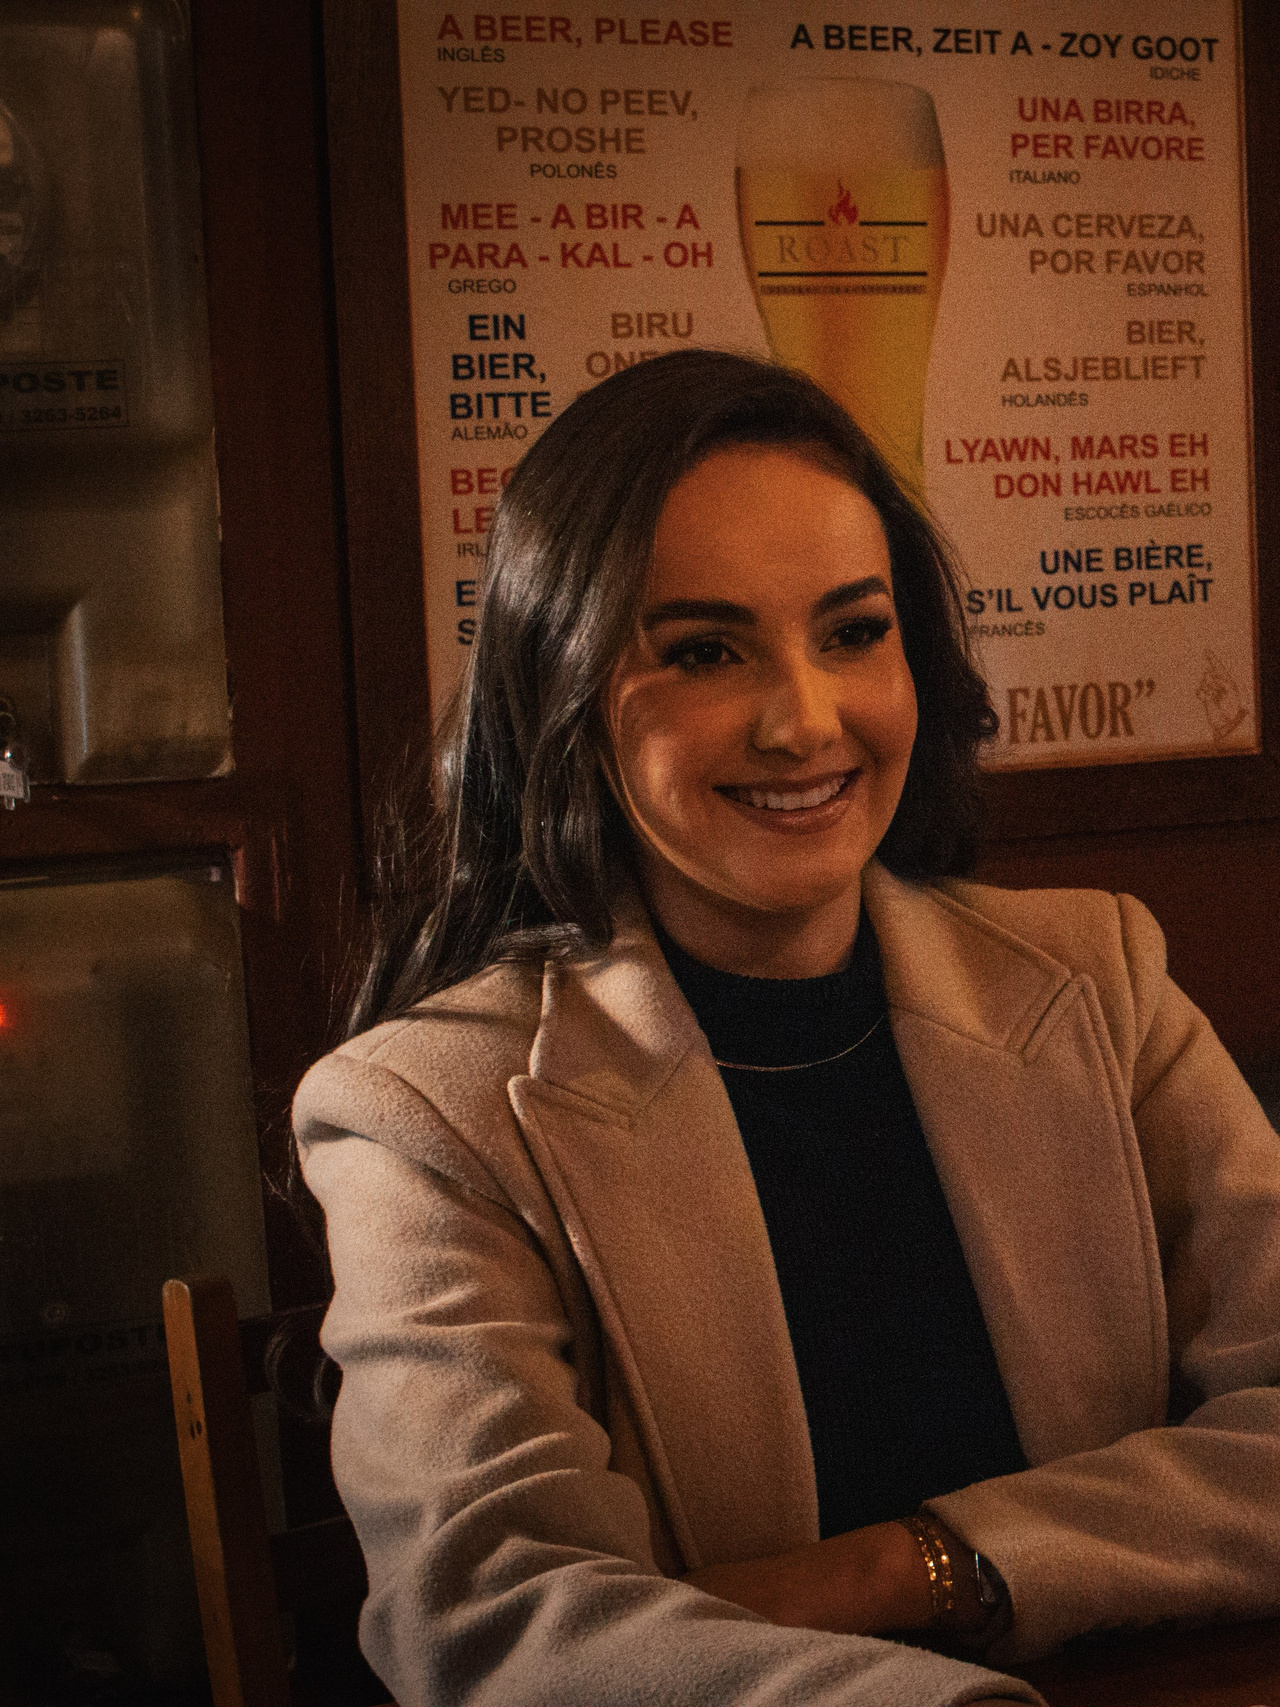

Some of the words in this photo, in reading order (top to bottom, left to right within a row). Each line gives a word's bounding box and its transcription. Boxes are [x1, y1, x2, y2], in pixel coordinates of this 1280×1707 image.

[438, 14, 463, 40] A
[474, 14, 582, 48] BEER,
[595, 18, 732, 47] PLEASE
[791, 24, 814, 49] A
[824, 25, 922, 56] BEER,
[933, 28, 1001, 54] ZEIT
[1011, 31, 1032, 55] A
[1060, 32, 1122, 58] ZOY
[1132, 35, 1219, 62] GOOT
[437, 45, 505, 63] INGLÊS
[1149, 66, 1201, 81] IDICHE
[438, 86, 525, 113] YED-
[537, 88, 588, 114] NO
[600, 89, 697, 121] PEEV,
[1018, 97, 1084, 122] UNA
[1094, 99, 1195, 127] BIRRA,
[497, 126, 645, 153] PROSHE
[1011, 133, 1073, 158] PER
[1084, 135, 1204, 161] FAVORE
[530, 161, 618, 179] POLONÊS
[1010, 170, 1081, 185] ITALIANO
[441, 203, 518, 229] MEE
[551, 203, 575, 229] A
[586, 204, 644, 229] BIR
[676, 204, 699, 229] A
[976, 213, 1043, 238] UNA
[1052, 213, 1204, 243] CERVEZA,
[429, 242, 528, 269] PARA
[561, 242, 632, 268] KAL
[664, 242, 712, 268] OH
[778, 235, 908, 264] ROAST
[1029, 249, 1095, 274] POR
[1105, 250, 1205, 275] FAVOR
[448, 278, 517, 294] GREGO
[1127, 283, 1208, 297] ESPANHOL
[469, 315, 525, 340] EIN
[611, 312, 693, 338] BIRU
[1127, 320, 1204, 346] BIER,
[452, 353, 546, 383] BIER,
[585, 351, 658, 378] ON
[1001, 355, 1205, 382] ALSJEBLIEFT
[450, 391, 551, 419] BITTE
[451, 421, 528, 441] ALEMÃO
[945, 437, 1059, 464] LYAWN,
[1071, 434, 1158, 459] MARS
[1169, 433, 1208, 457] EH
[995, 473, 1061, 498] DON
[1073, 471, 1161, 495] HAWL
[1171, 469, 1209, 493] EH
[1041, 549, 1103, 575] UNE
[1114, 540, 1211, 575] BIÈRE,
[1032, 583, 1118, 611] VOUS
[1129, 573, 1213, 606] PLAÎT
